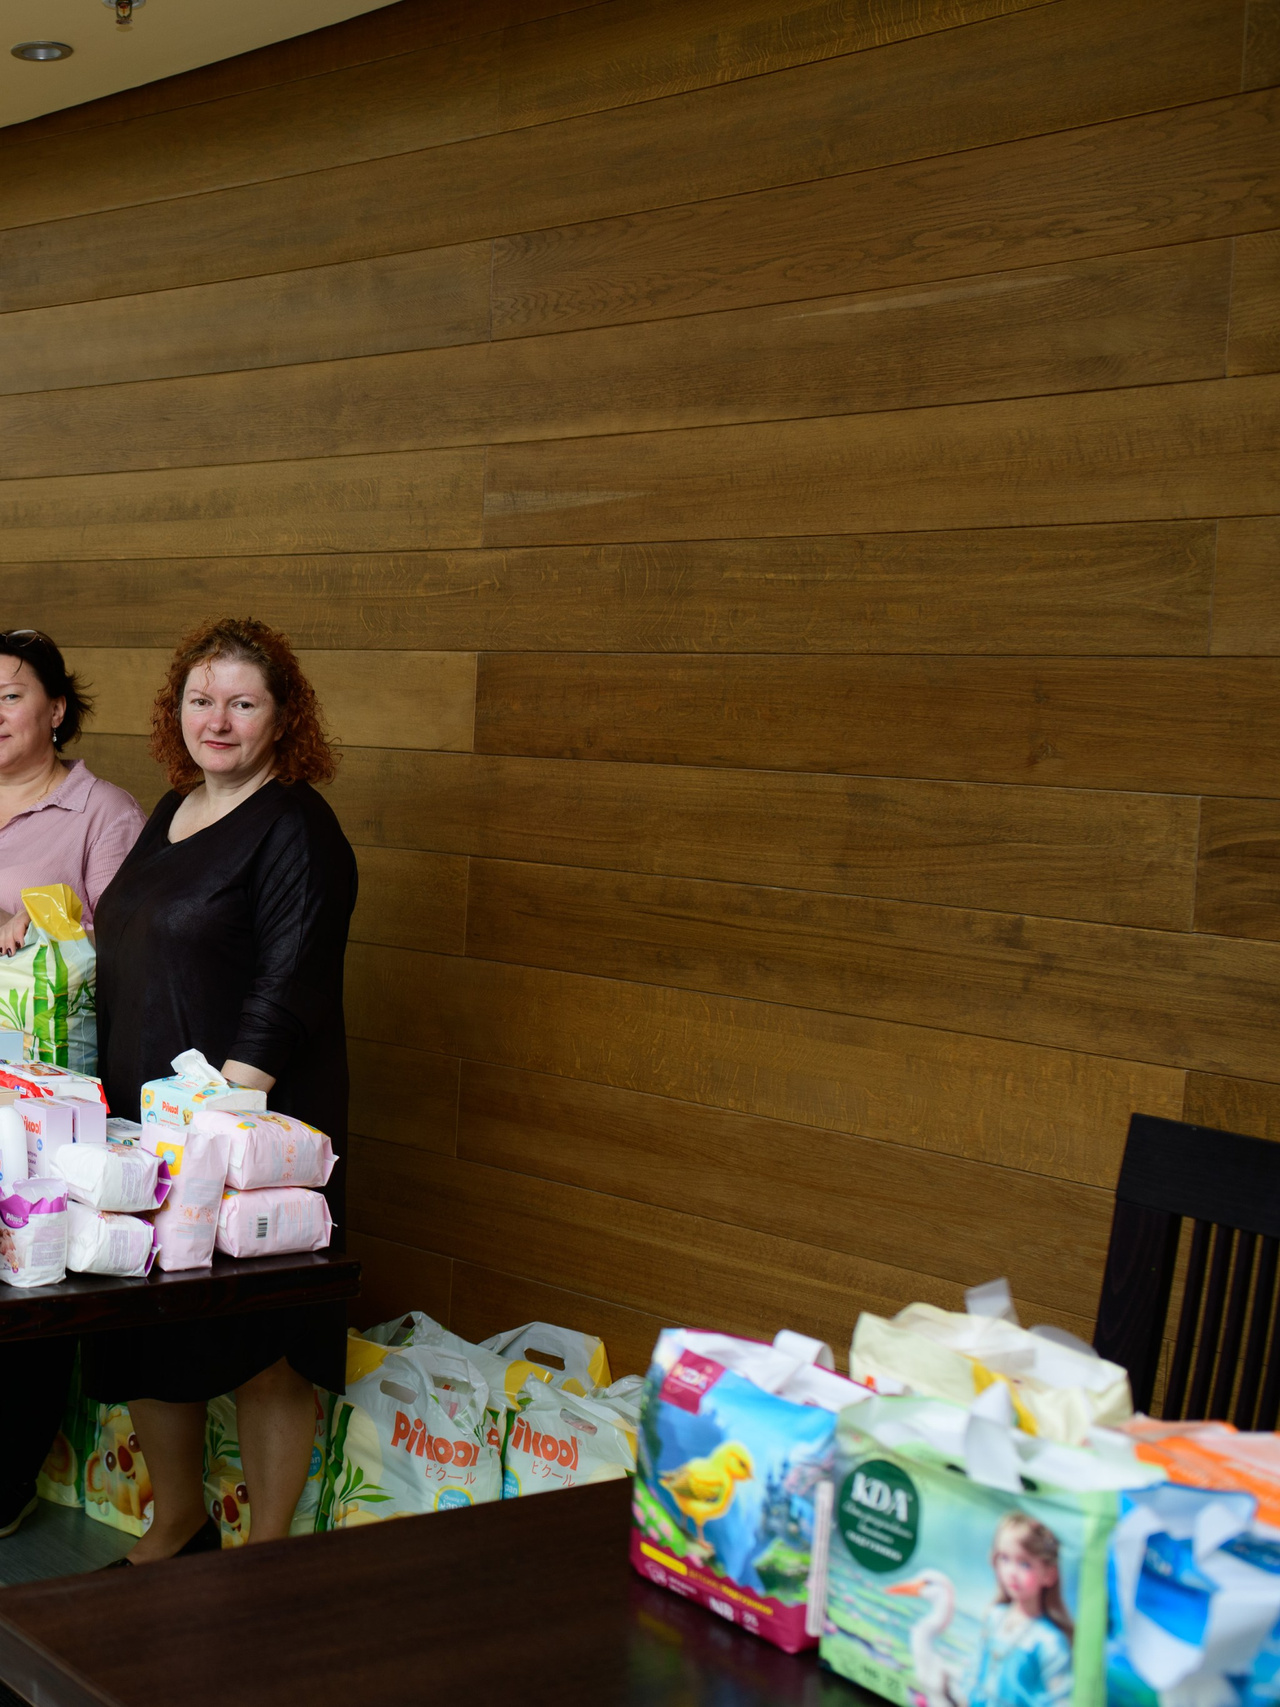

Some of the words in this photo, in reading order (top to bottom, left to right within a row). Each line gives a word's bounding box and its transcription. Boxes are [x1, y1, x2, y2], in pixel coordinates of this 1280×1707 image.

[390, 1410, 480, 1468] Pikool
[425, 1463, 477, 1486] ピクール
[850, 1472, 908, 1522] KDA
